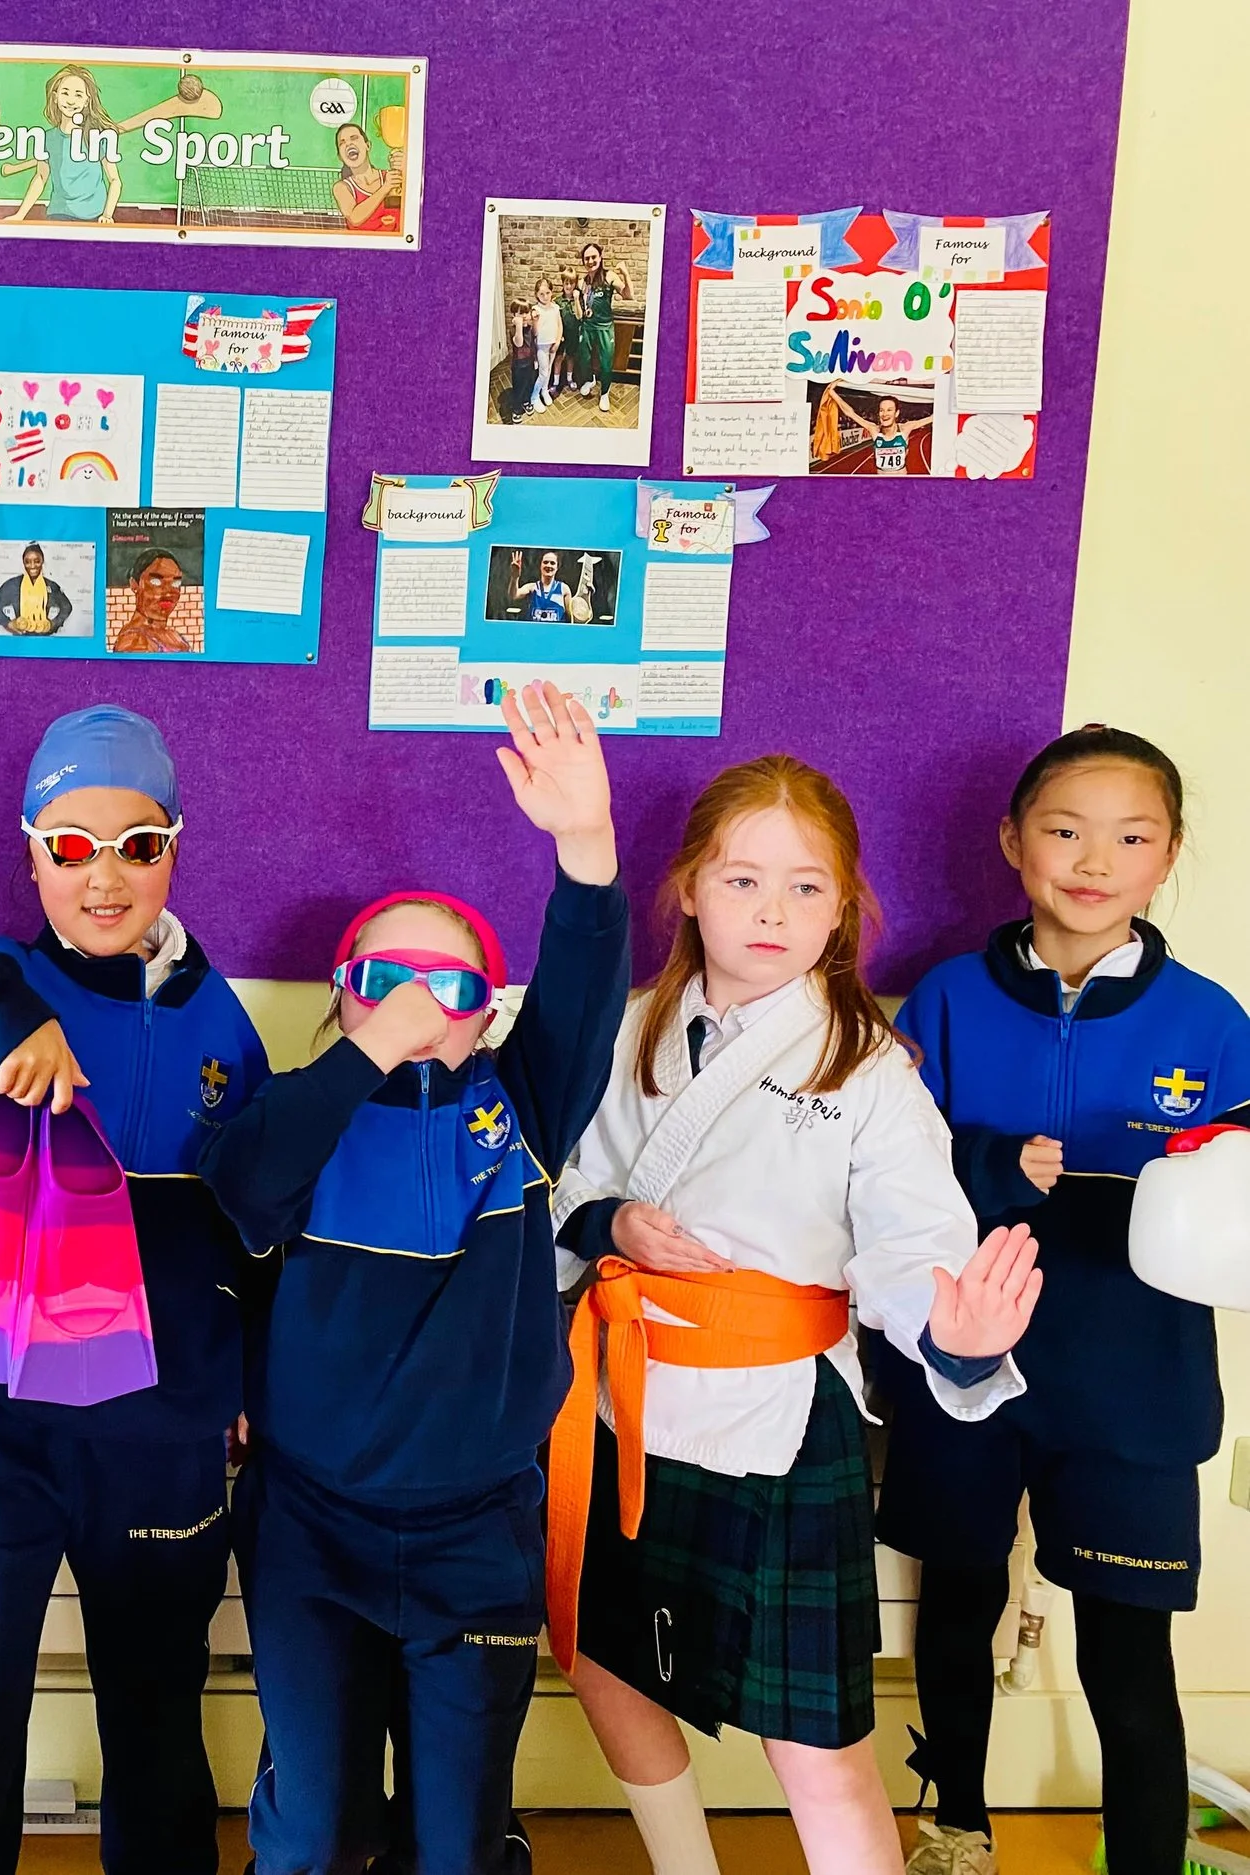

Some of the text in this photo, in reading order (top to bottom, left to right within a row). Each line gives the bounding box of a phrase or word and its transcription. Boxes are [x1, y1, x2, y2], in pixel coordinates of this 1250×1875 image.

[320, 102, 345, 114] GAA
[70, 113, 122, 163] in
[140, 118, 291, 181] Sport
[935, 238, 990, 250] Famous
[738, 246, 817, 260] background
[950, 253, 971, 266] for
[806, 276, 883, 321] Sonia
[213, 327, 267, 340] Famous
[228, 343, 248, 356] for
[785, 329, 913, 374] Sullivan
[880, 456, 902, 468] 748
[387, 508, 466, 521] background
[666, 507, 718, 521] Famous
[680, 522, 700, 536] for
[811, 1097, 842, 1120] Dojo
[470, 1171, 488, 1186] THE
[128, 1529, 148, 1539] THE
[150, 1525, 198, 1539] TERESIAN
[1073, 1546, 1094, 1560] THE
[1095, 1552, 1153, 1569] TERESIAN
[463, 1633, 484, 1645] THE
[485, 1635, 528, 1647] TERESIAN
